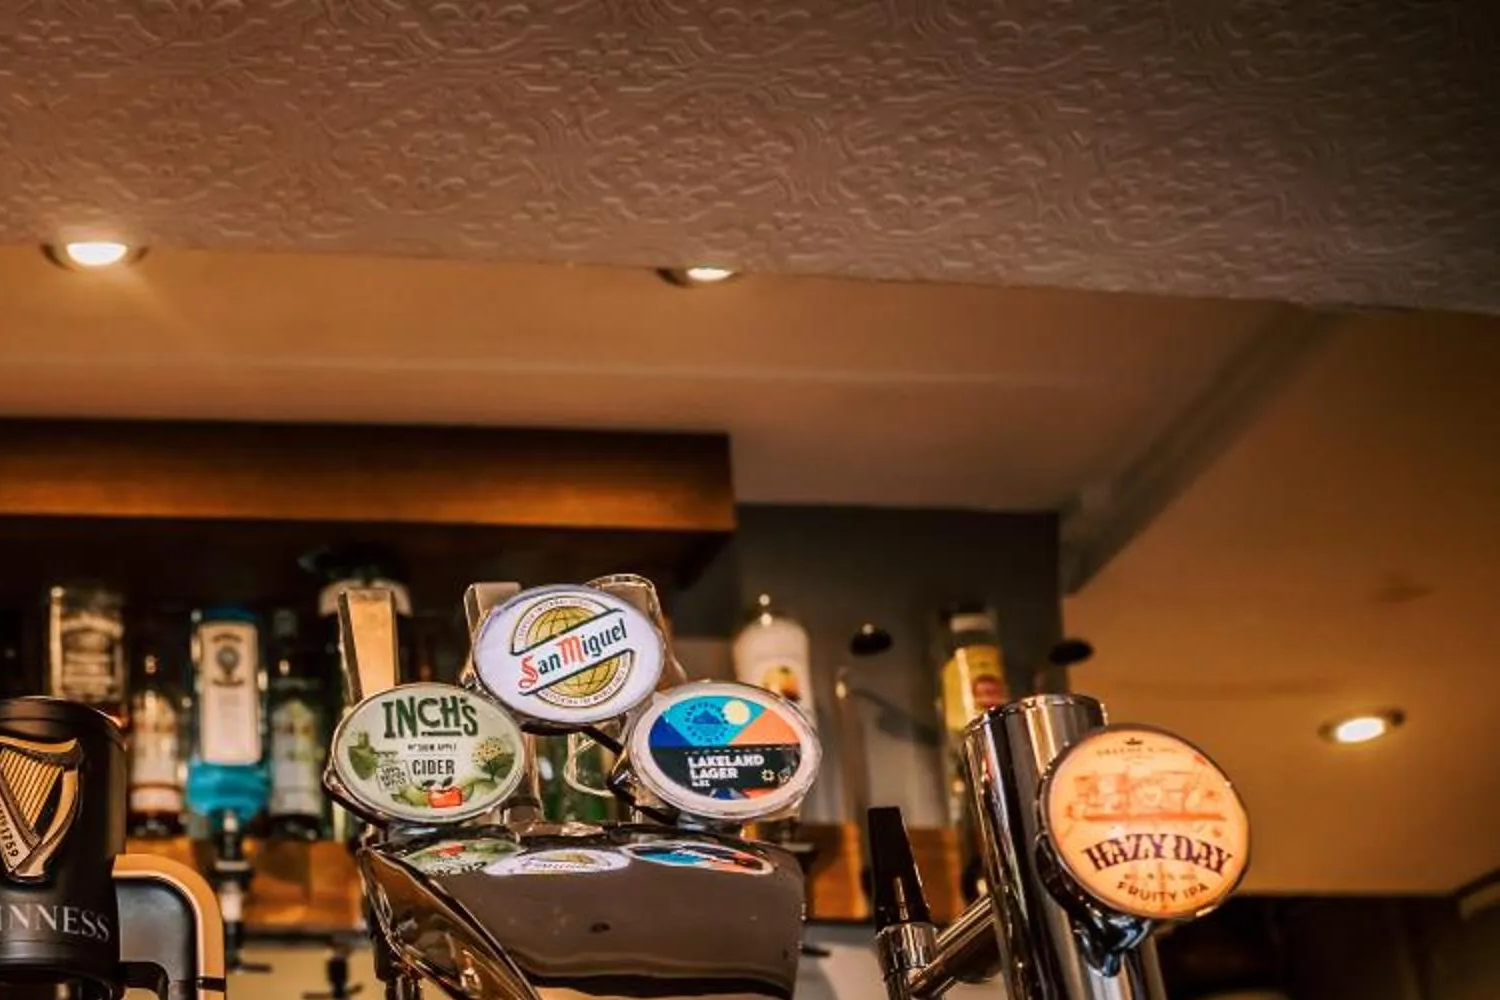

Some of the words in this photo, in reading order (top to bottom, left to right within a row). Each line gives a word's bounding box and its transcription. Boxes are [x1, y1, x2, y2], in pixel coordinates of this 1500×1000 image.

[412, 759, 456, 776] CIDER
[687, 754, 765, 768] LAKELAND
[689, 767, 739, 779] LAGER
[0, 827, 19, 858] 1759
[1082, 833, 1170, 872] HAZY
[1174, 834, 1233, 876] DAY
[1117, 881, 1177, 902] FRUITY
[1182, 882, 1209, 899] IPA
